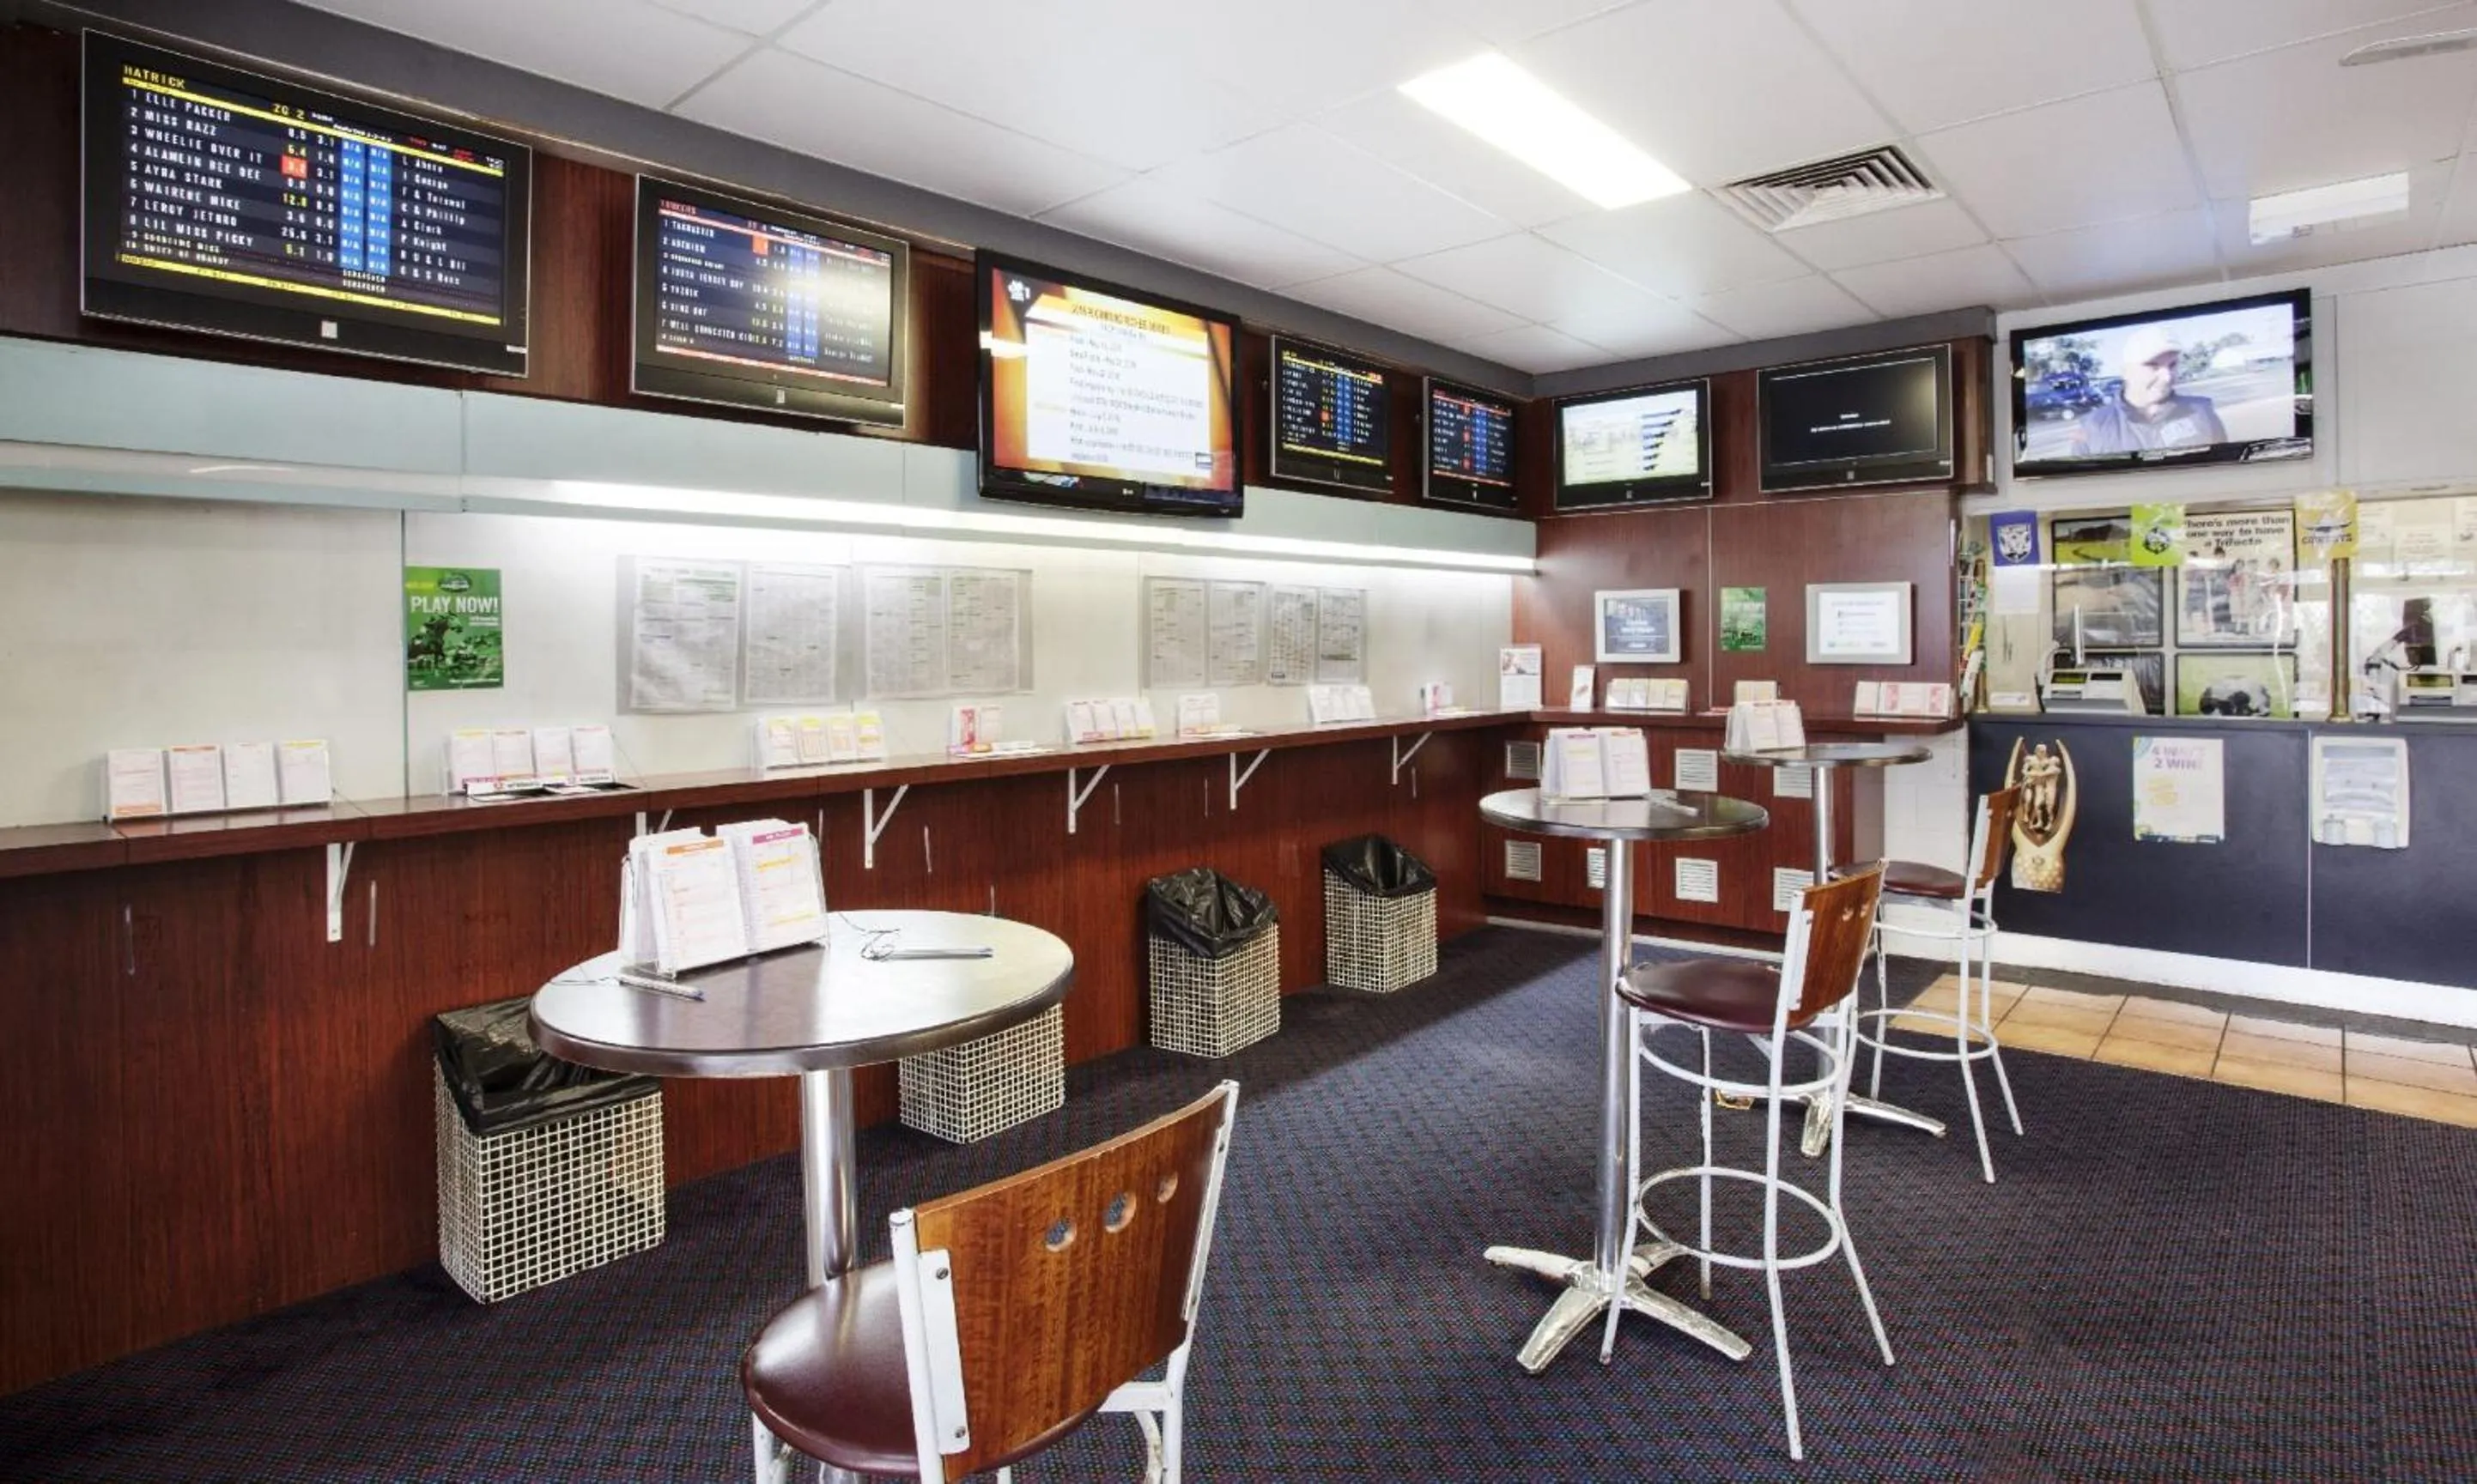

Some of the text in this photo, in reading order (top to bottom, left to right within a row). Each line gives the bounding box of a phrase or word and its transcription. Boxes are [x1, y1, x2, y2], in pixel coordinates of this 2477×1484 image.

[2184, 518, 2222, 528] here's
[410, 596, 499, 613] PLAY NOW!
